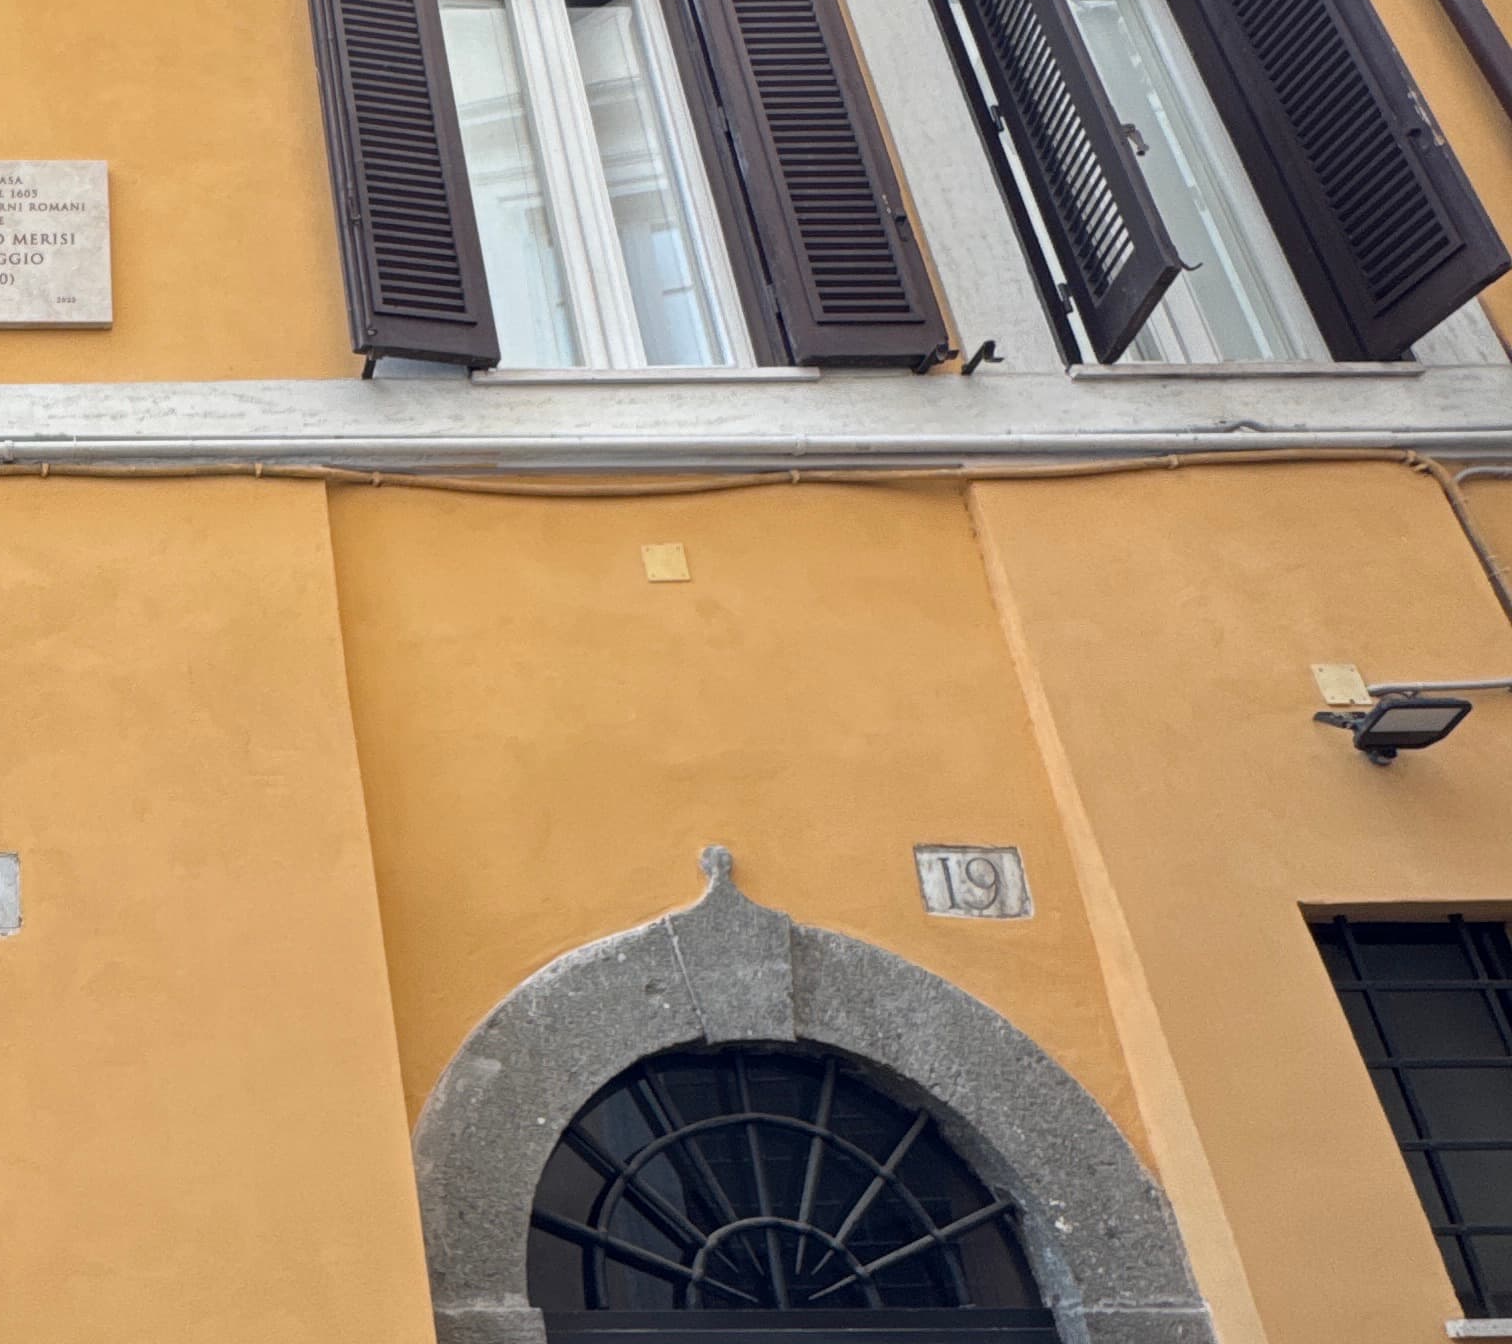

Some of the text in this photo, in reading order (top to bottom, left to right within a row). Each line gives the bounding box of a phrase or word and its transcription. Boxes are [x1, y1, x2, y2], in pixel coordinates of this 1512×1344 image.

[29, 202, 86, 213] ROMANI
[12, 233, 76, 246] MERISI
[936, 857, 1001, 911] 19
